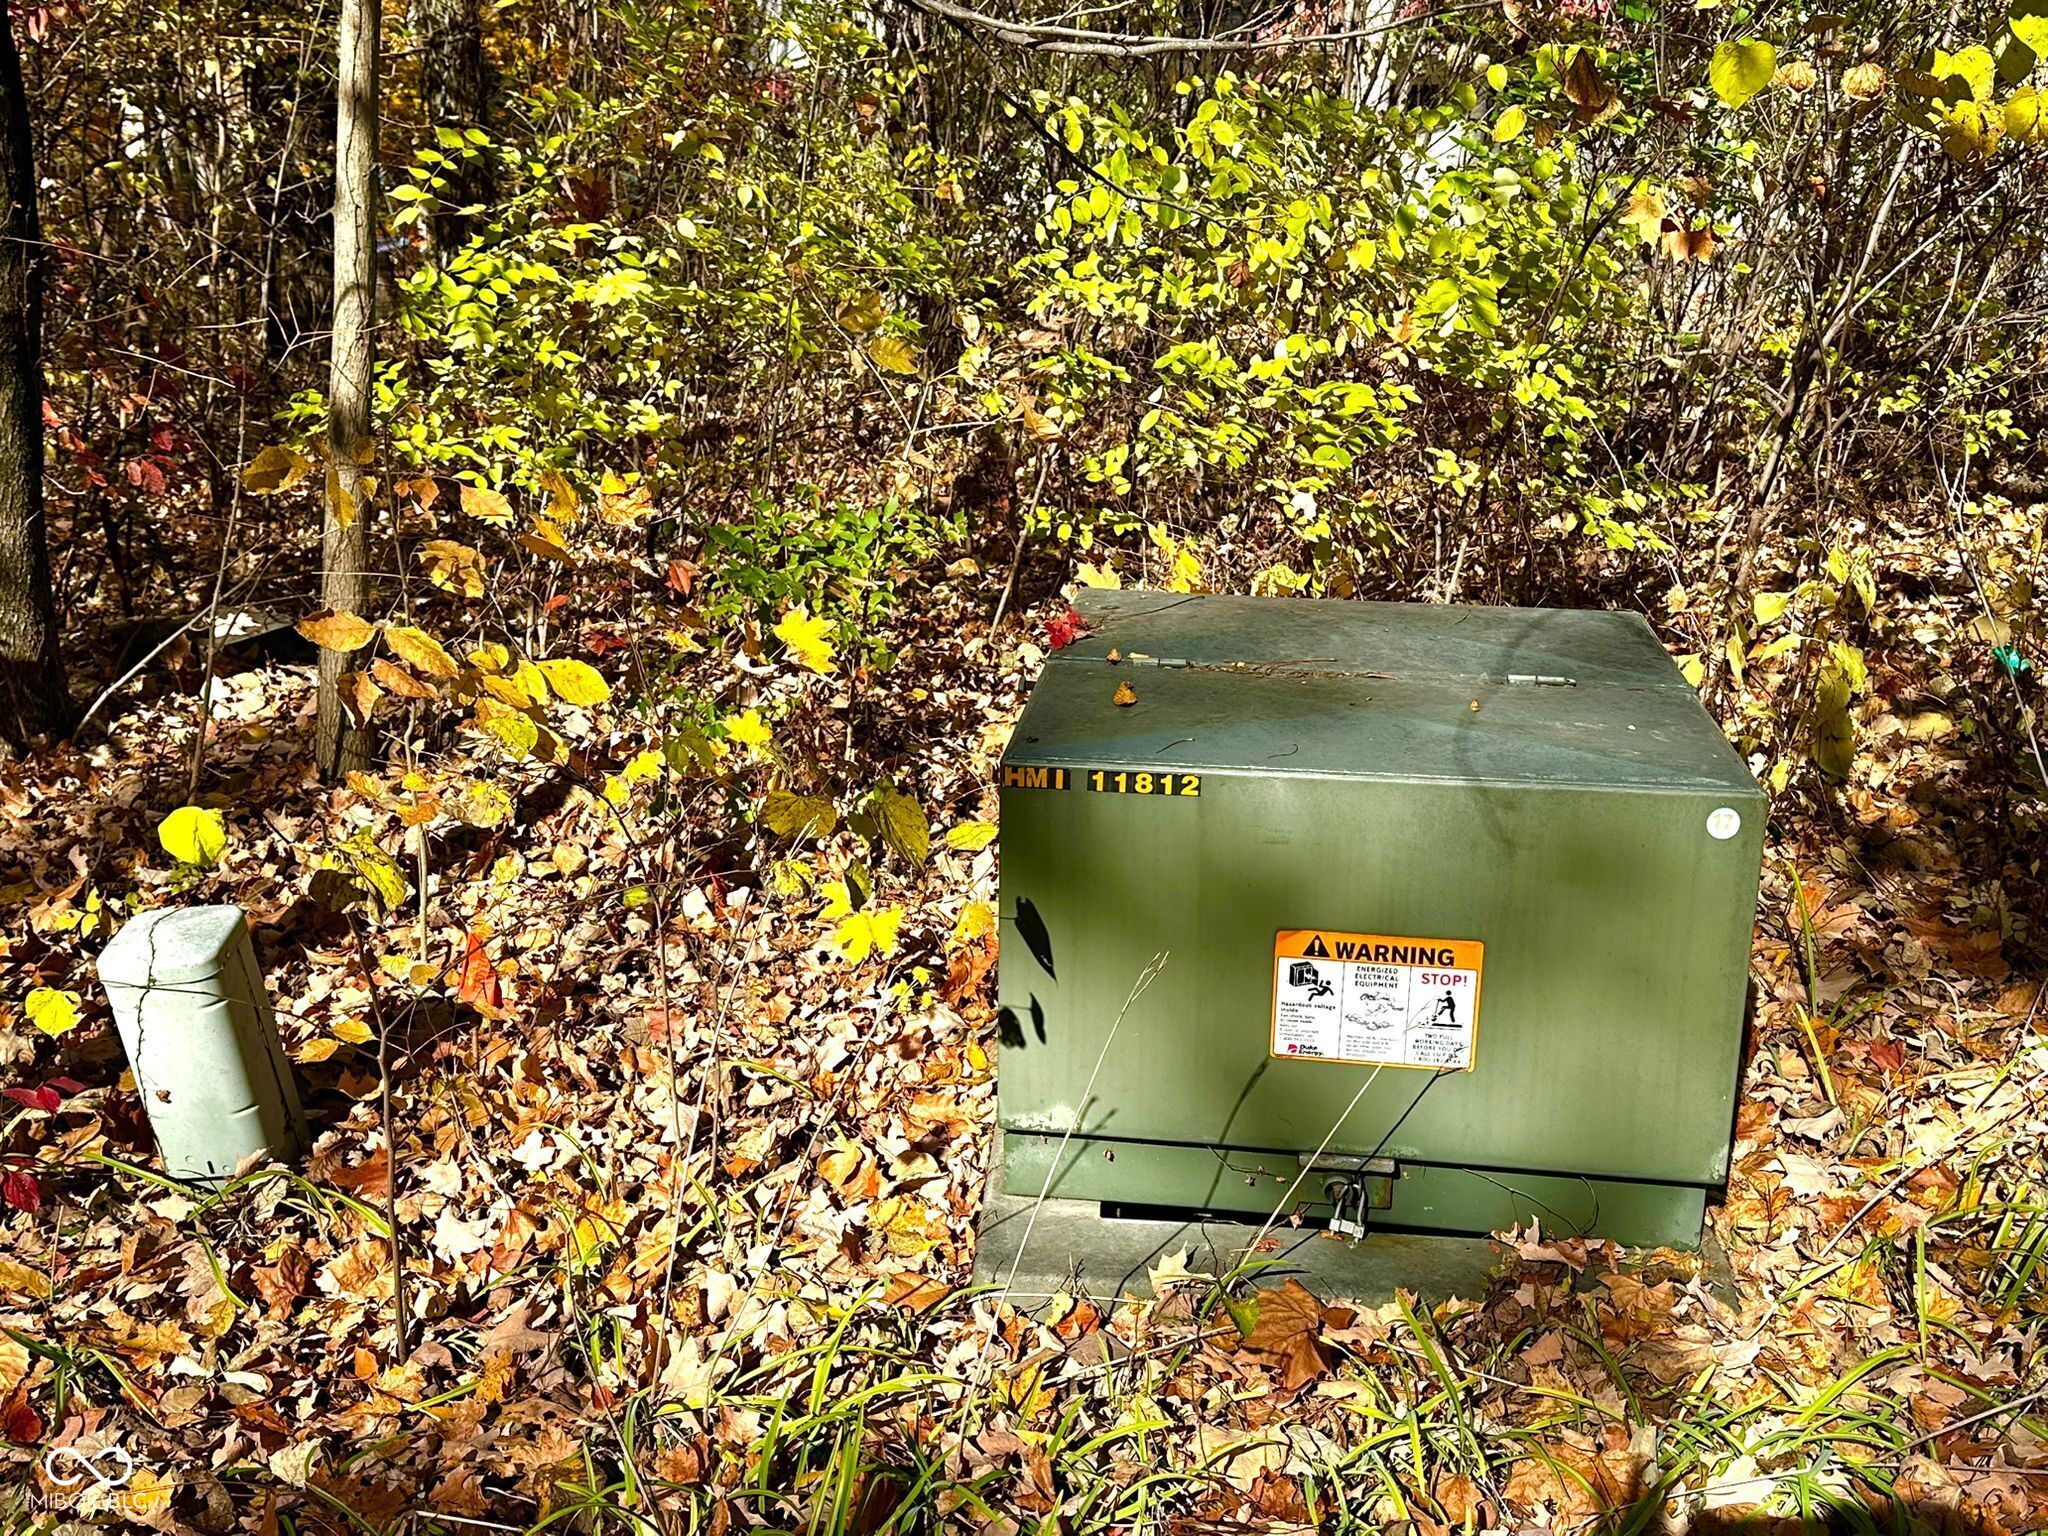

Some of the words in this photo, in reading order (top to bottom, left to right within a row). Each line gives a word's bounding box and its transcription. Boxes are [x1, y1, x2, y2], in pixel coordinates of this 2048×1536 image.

[1092, 771, 1200, 797] 11812
[1335, 941, 1455, 967] WARNING
[1356, 965, 1399, 974] ENERGIZED
[1354, 973, 1399, 982] ELECTRICAL
[1421, 973, 1468, 987] STOP!
[1354, 981, 1399, 989] EQUIPMENT
